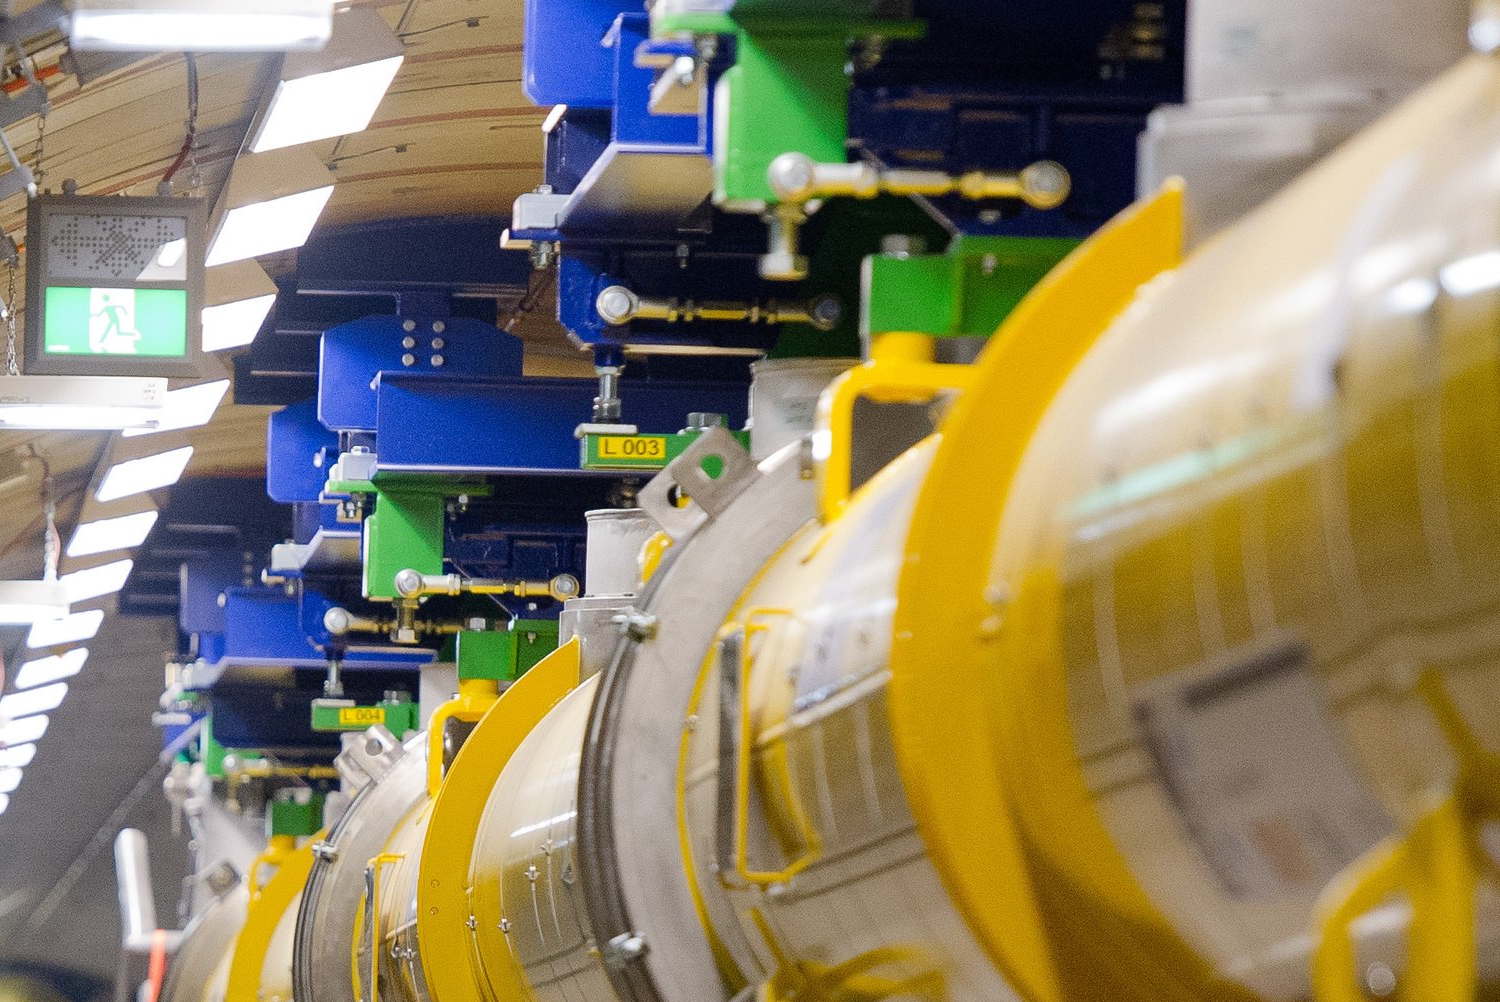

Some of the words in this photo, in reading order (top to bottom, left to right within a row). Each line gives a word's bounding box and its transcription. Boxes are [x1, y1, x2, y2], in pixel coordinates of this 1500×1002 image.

[604, 438, 617, 455] L
[622, 438, 660, 456] 003
[343, 708, 351, 721] L
[356, 708, 381, 721] 004
